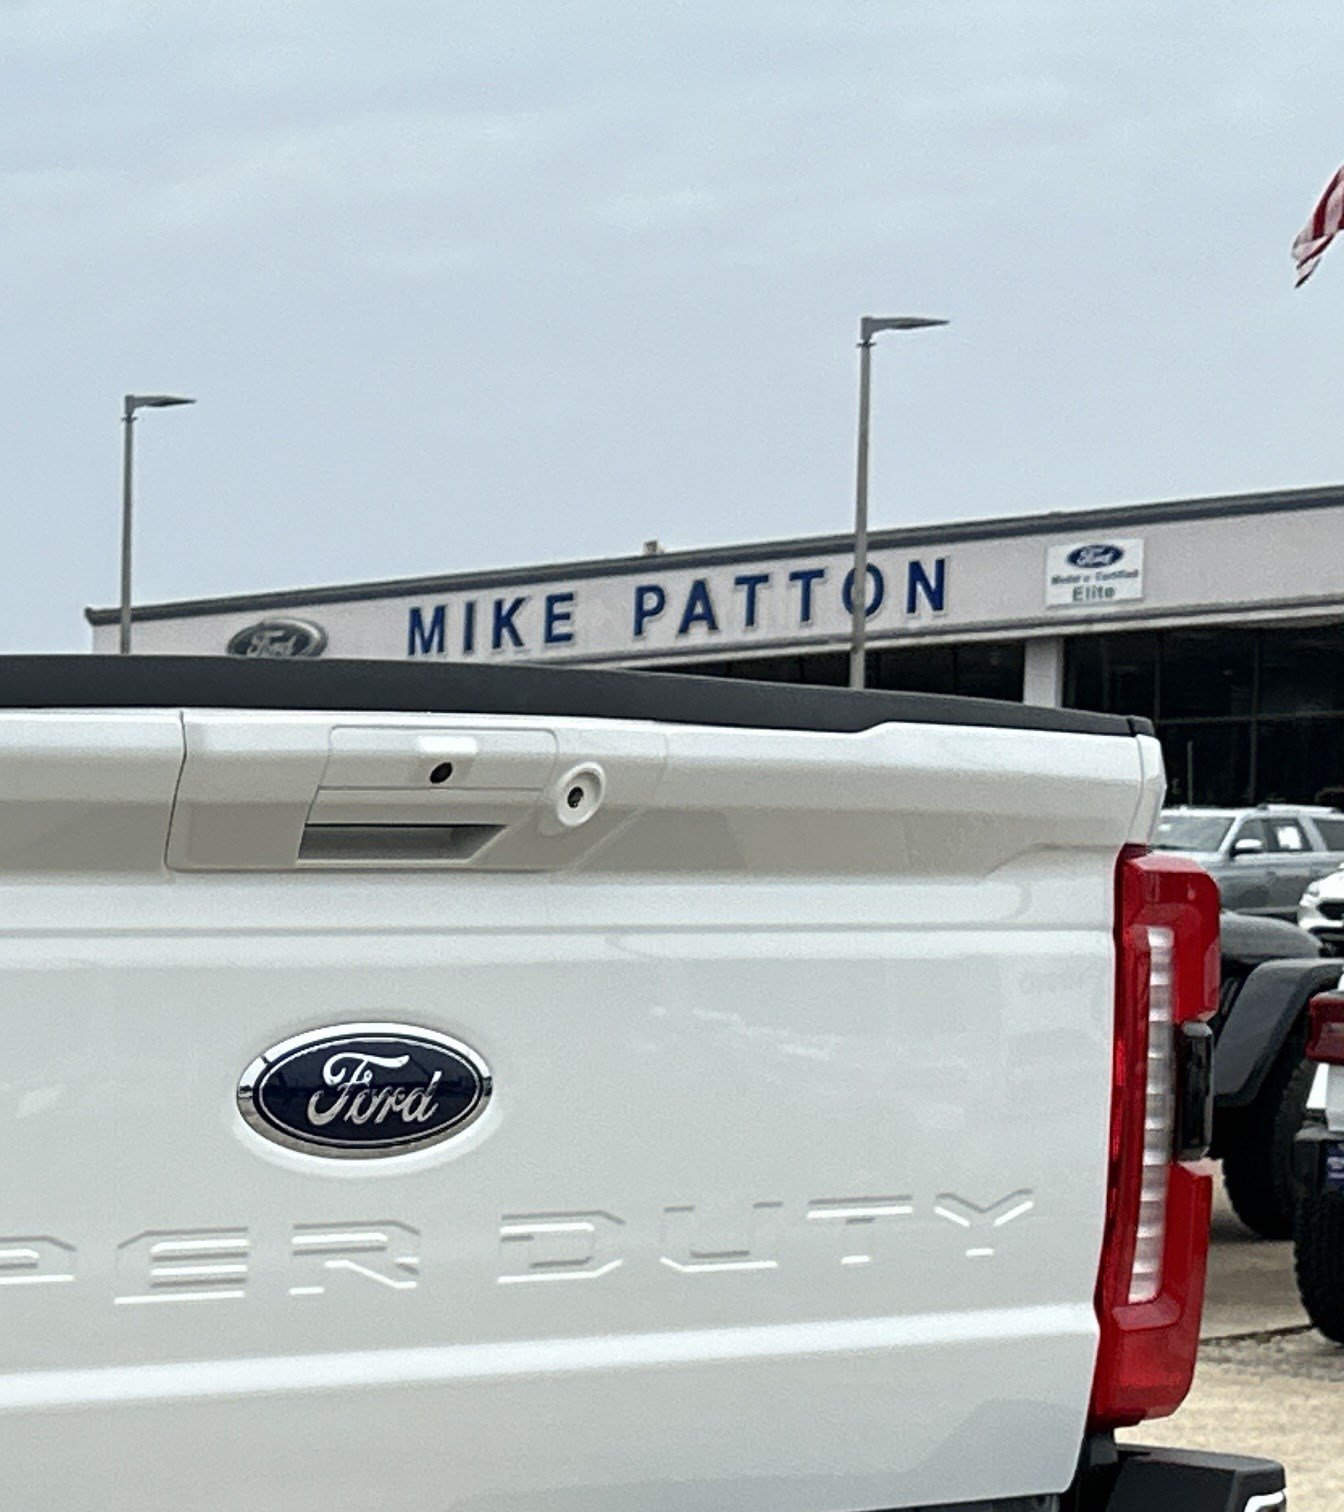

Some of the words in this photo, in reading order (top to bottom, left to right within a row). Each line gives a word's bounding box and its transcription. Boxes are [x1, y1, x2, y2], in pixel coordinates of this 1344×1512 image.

[407, 591, 576, 656] MIKE
[633, 557, 946, 637] PATTON
[306, 1051, 442, 1127] Ford
[496, 1187, 1034, 1285] DUTY
